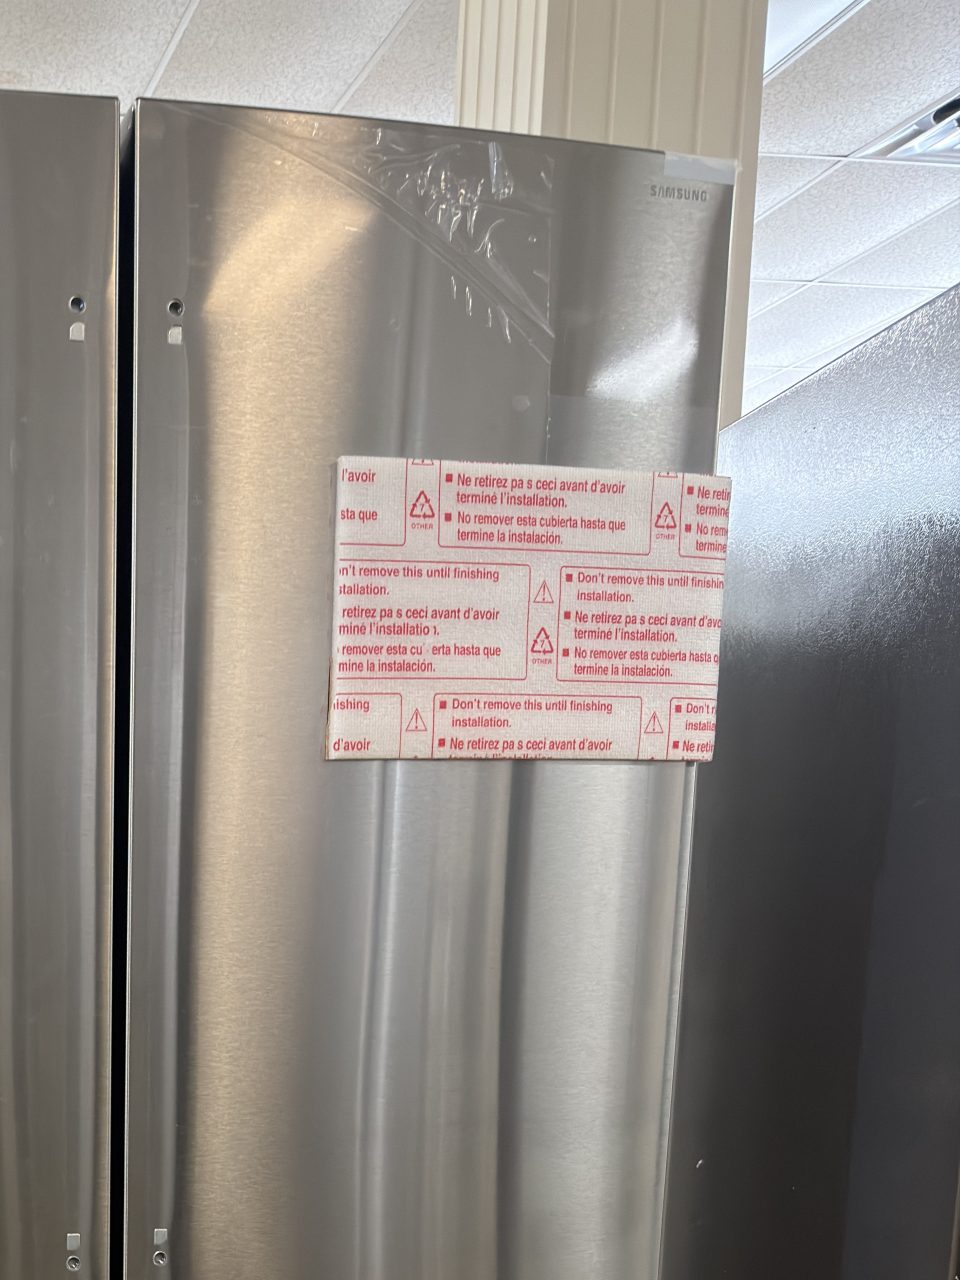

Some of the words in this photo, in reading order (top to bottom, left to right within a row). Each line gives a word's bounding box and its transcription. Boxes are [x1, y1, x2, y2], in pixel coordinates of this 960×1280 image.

[650, 184, 706, 202] SAMSUNG
[458, 473, 472, 487] Ne
[474, 475, 507, 488] retirez
[511, 478, 524, 492] pa
[526, 479, 533, 489] s
[536, 478, 557, 490] ceci
[560, 480, 588, 492] avant
[591, 479, 625, 494] d'avoir
[457, 491, 497, 504] terminé
[500, 492, 567, 508] l'installation.
[457, 511, 471, 524] No
[474, 514, 513, 526] remover
[516, 514, 537, 526] esta
[539, 514, 578, 528] cubierta
[580, 516, 606, 529] hasta
[608, 519, 625, 533] que
[457, 529, 494, 542] termine
[497, 529, 506, 542] la
[508, 530, 563, 544] instalación.
[578, 571, 604, 584] Don't
[608, 574, 644, 585] remove
[647, 574, 664, 586] this
[668, 575, 688, 587] until
[577, 589, 634, 602] installation.
[575, 611, 588, 623] Ne
[591, 612, 622, 624] retirez
[625, 615, 637, 628] pa
[640, 615, 645, 625] s
[648, 614, 668, 626] ceci
[670, 616, 697, 627] avant
[574, 627, 611, 640] terminé
[615, 628, 677, 642] l'installation.
[574, 646, 587, 658] No
[590, 649, 626, 660] remover
[630, 649, 649, 660] esta
[651, 649, 686, 661] cubierta
[689, 649, 712, 662] hasta
[574, 663, 608, 675] termine
[611, 663, 619, 675] la
[622, 663, 672, 676] instalación.
[452, 698, 480, 710] Don't
[483, 701, 521, 710] remove
[524, 700, 542, 710] this
[546, 700, 566, 711] until
[570, 700, 612, 714] finishing
[452, 717, 512, 728] installation.
[450, 739, 464, 750] Ne
[467, 739, 499, 750] retirez
[502, 741, 515, 752] pa
[518, 741, 523, 750] s
[526, 739, 546, 750] ceci
[549, 740, 576, 750] avant
[579, 739, 612, 750] d'avoir
